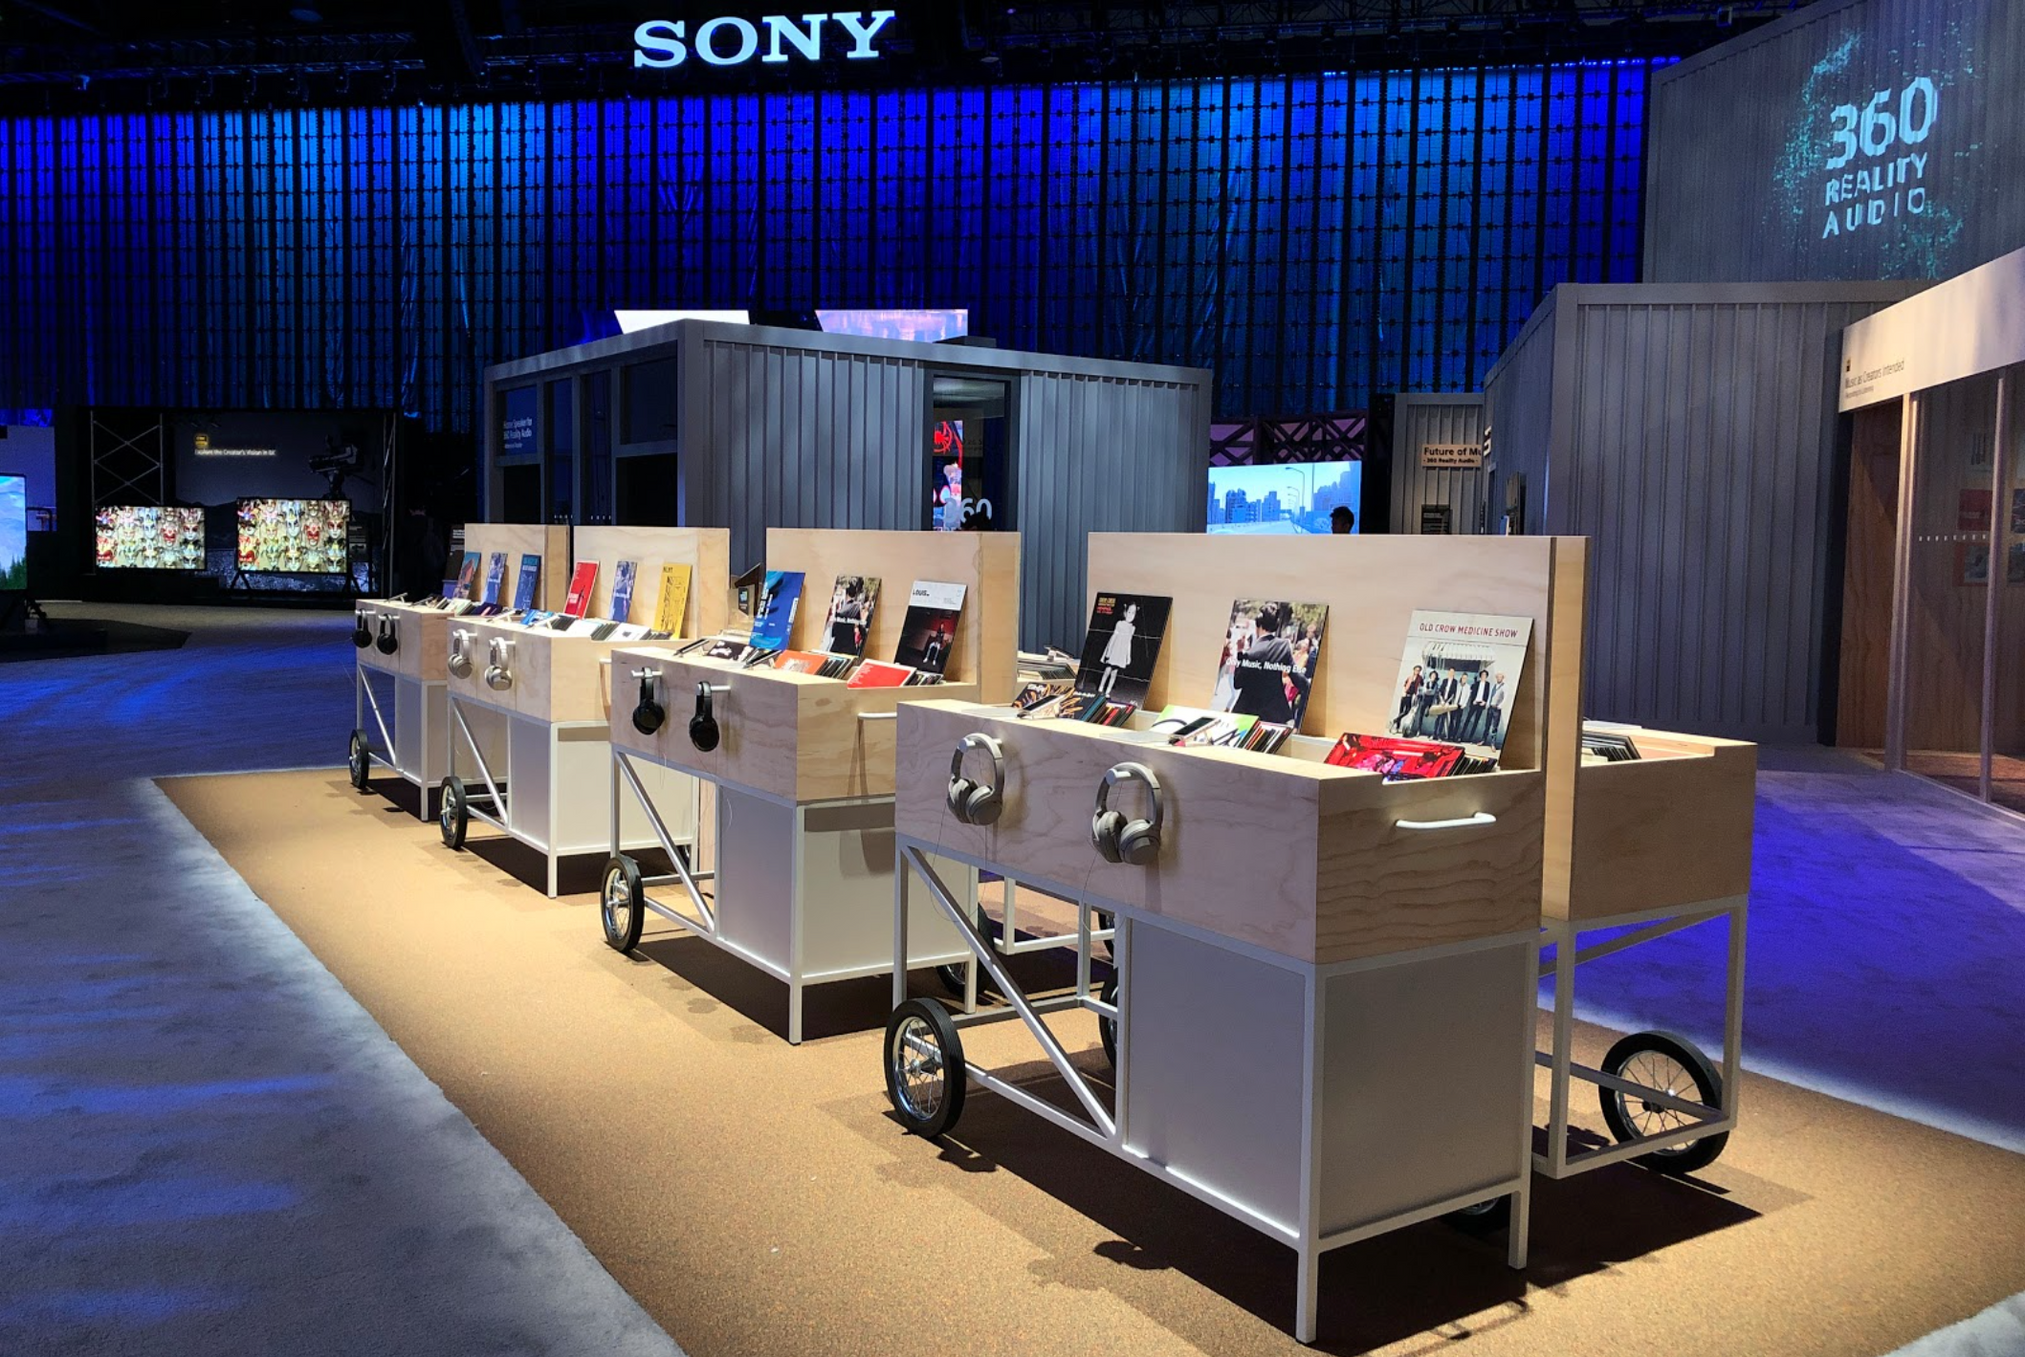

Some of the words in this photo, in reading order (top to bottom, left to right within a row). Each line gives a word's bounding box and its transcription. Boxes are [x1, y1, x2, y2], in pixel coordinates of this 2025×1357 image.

[634, 10, 895, 68] SONY
[1825, 76, 1938, 170] 360
[1825, 152, 1928, 206] REALITY
[1822, 187, 1926, 239] AUDIO
[1424, 447, 1455, 456] Future
[1457, 447, 1468, 456] of
[1419, 622, 1434, 632] OLD
[1434, 624, 1456, 634] CROW
[1457, 626, 1493, 637] MEDICINE
[1494, 629, 1519, 639] SHOW
[1242, 660, 1262, 669] Music,
[1263, 661, 1291, 673] Nothing
[1292, 664, 1306, 674] Else
